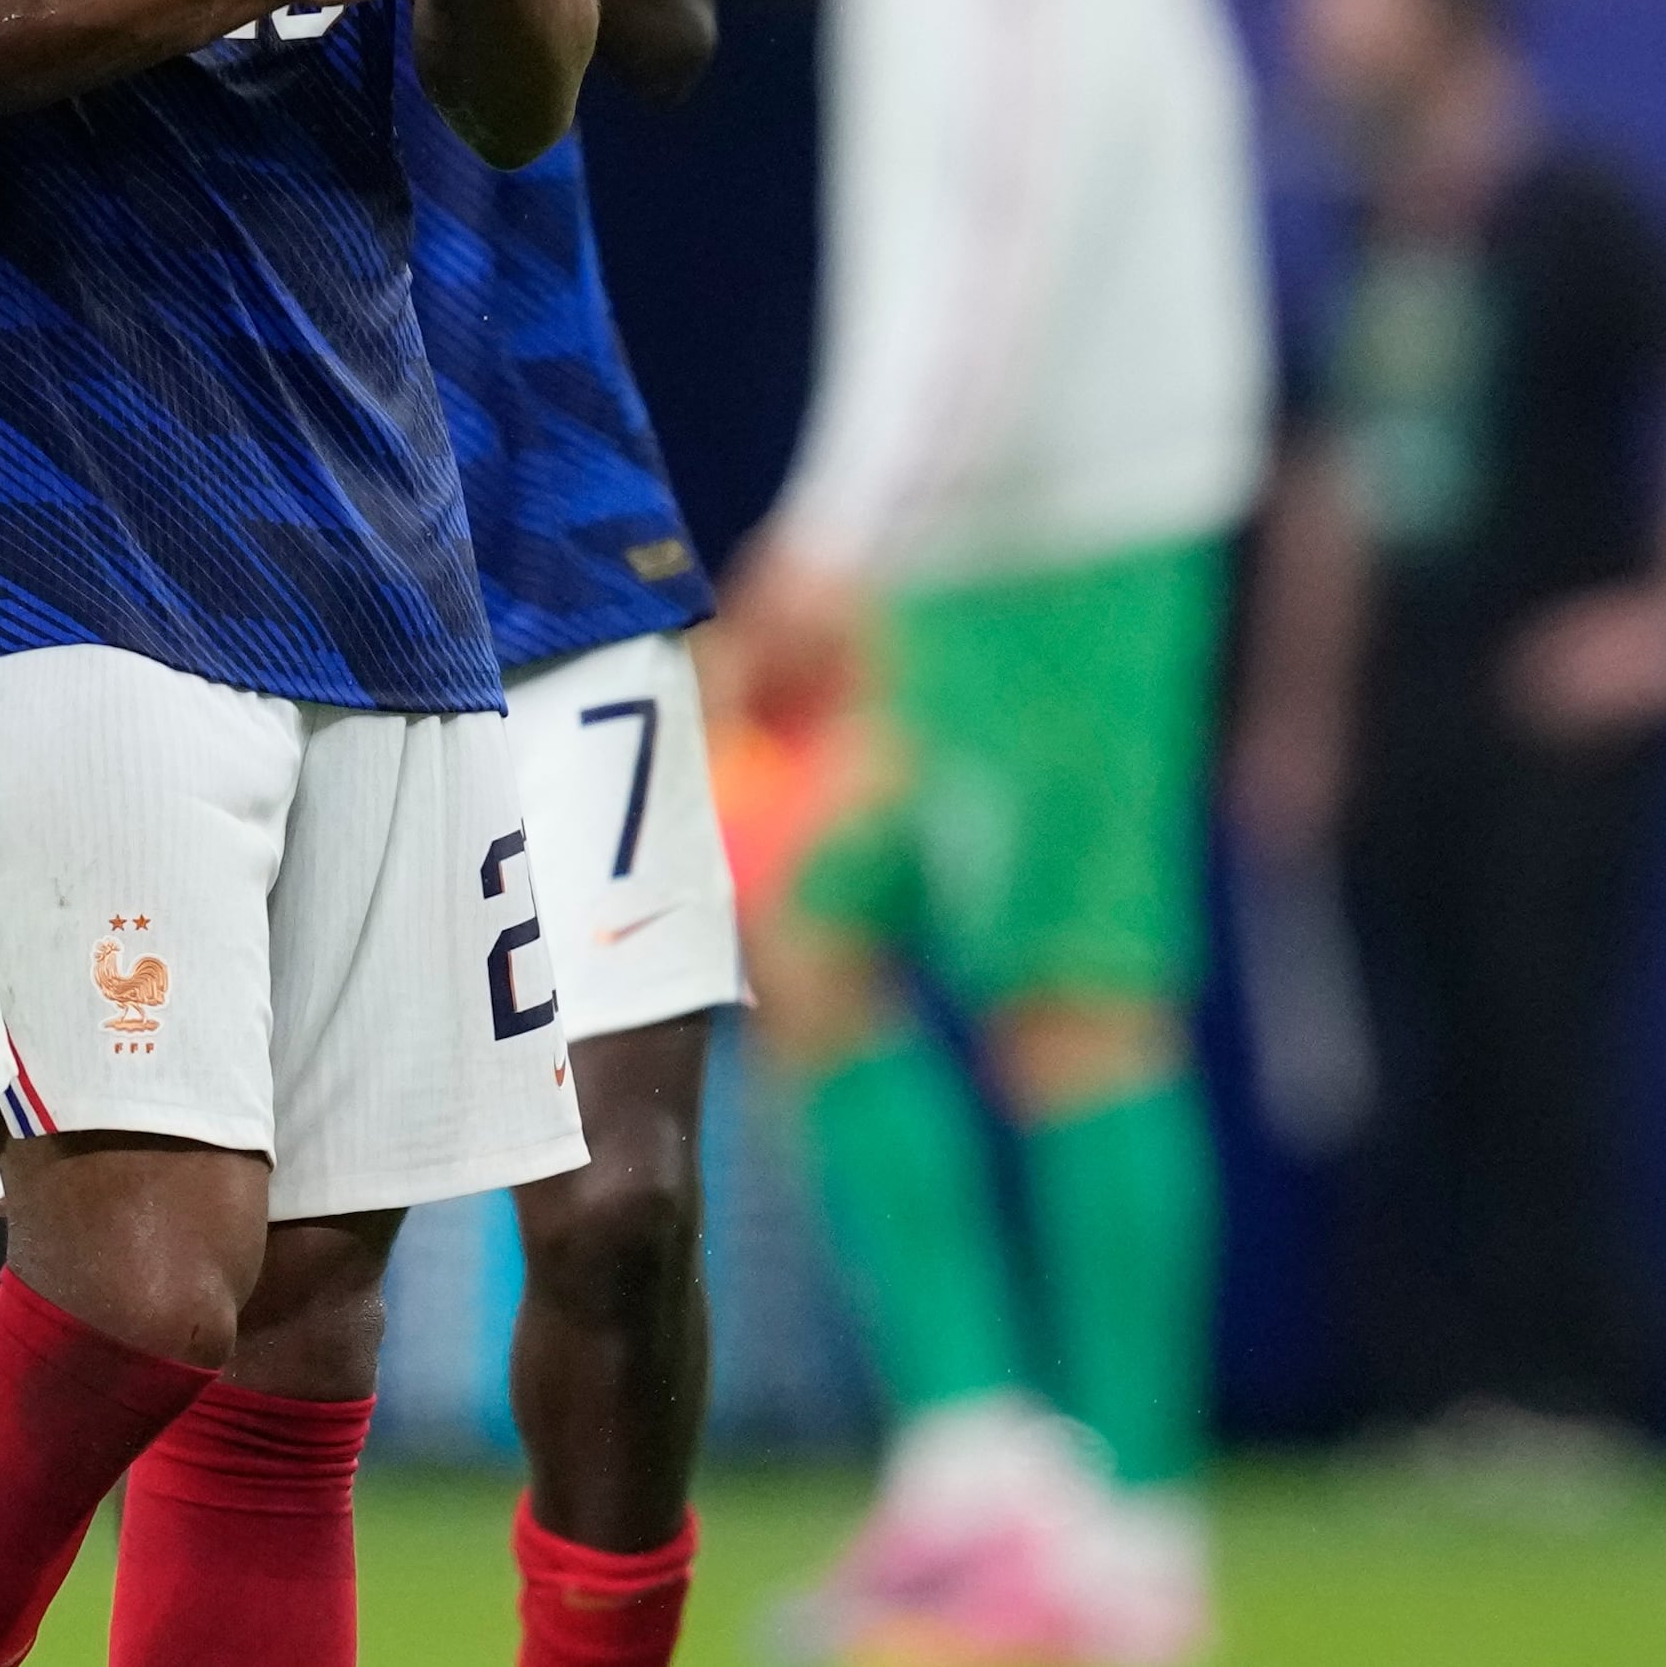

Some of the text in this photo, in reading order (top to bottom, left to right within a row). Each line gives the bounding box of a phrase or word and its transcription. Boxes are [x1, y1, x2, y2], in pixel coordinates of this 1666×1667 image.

[579, 698, 659, 881] 7
[480, 817, 559, 1041] 2
[114, 1042, 155, 1055] FFF
